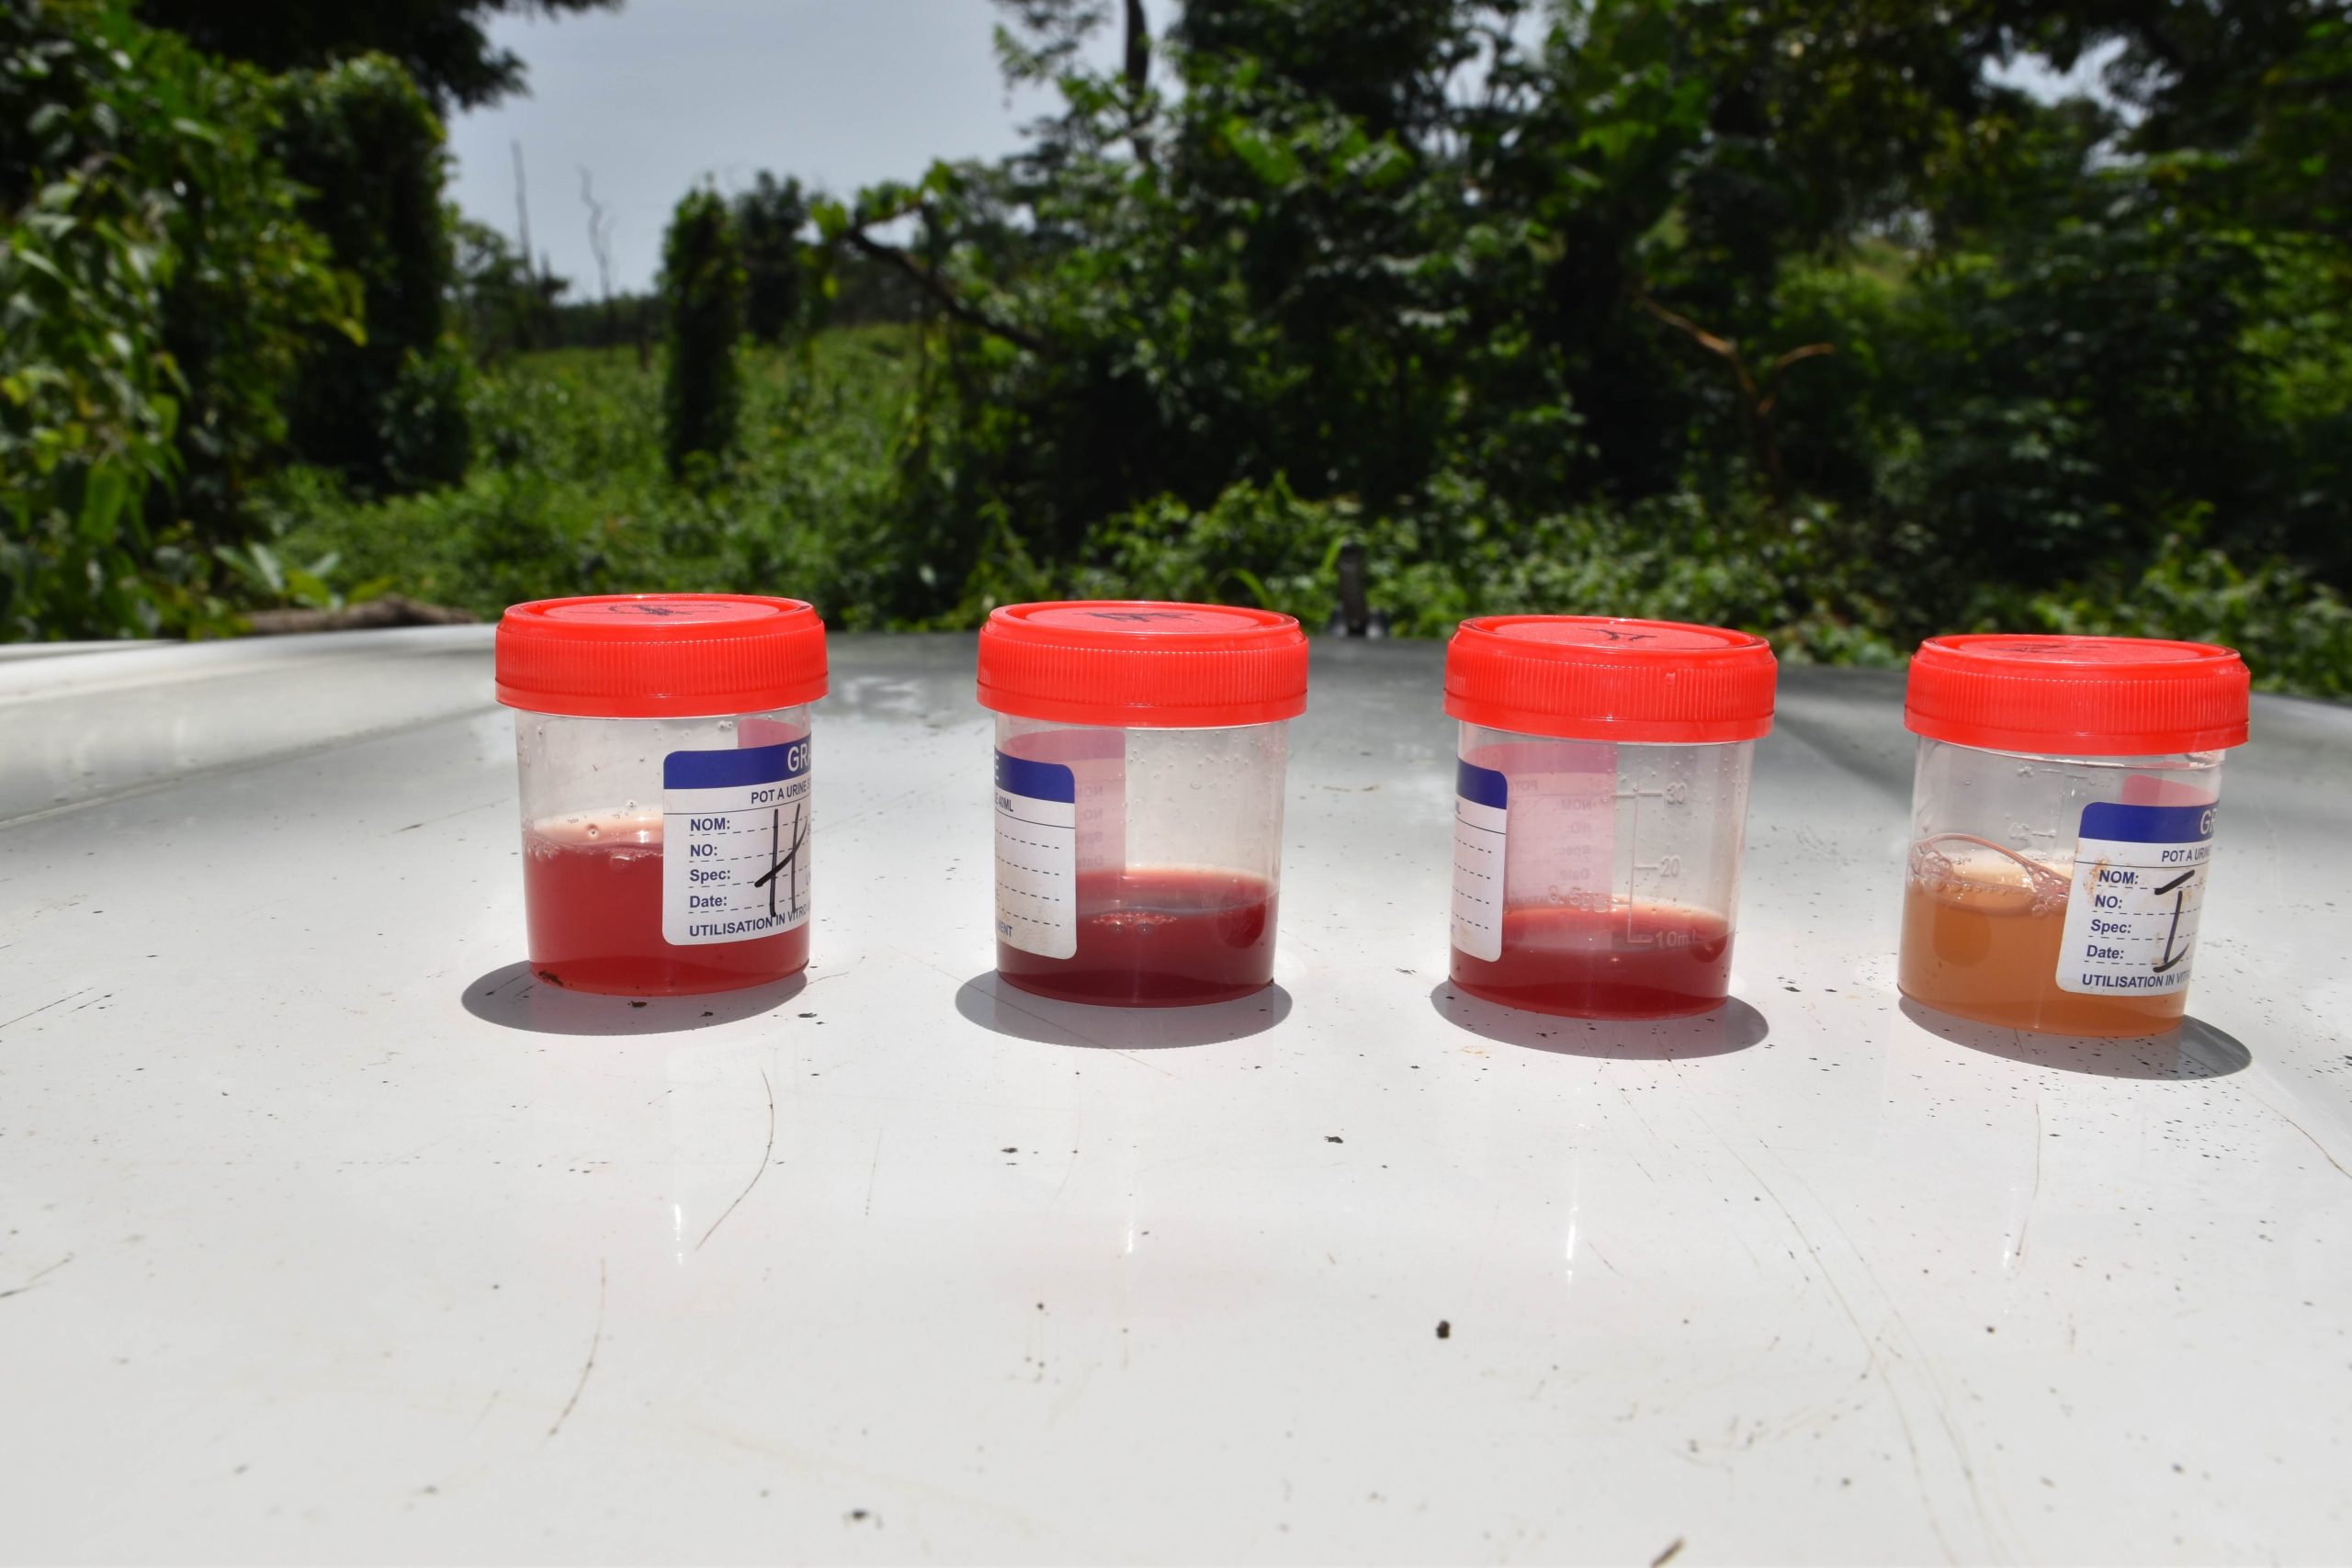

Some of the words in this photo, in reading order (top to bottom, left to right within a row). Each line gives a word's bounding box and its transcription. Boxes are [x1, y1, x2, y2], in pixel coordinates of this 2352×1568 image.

[751, 789, 775, 805] POT
[777, 788, 785, 800] A
[786, 782, 807, 798] URINE
[1666, 783, 1687, 807] 30
[690, 818, 730, 831] NOM:
[690, 844, 718, 857] NO:
[2162, 851, 2184, 863] POT
[2186, 849, 2193, 861] A
[754, 803, 808, 918] H
[1660, 856, 1679, 877] 20
[689, 869, 731, 884] Spec:
[2098, 870, 2139, 885] NOM:
[689, 895, 728, 908] Date:
[2094, 896, 2123, 909] NO:
[689, 916, 774, 937] UTILISATION
[775, 911, 786, 925] IN
[2090, 919, 2132, 934] Spec:
[2086, 944, 2125, 960] Date:
[2082, 973, 2165, 988] UTILISATION
[2165, 972, 2175, 987] IN
